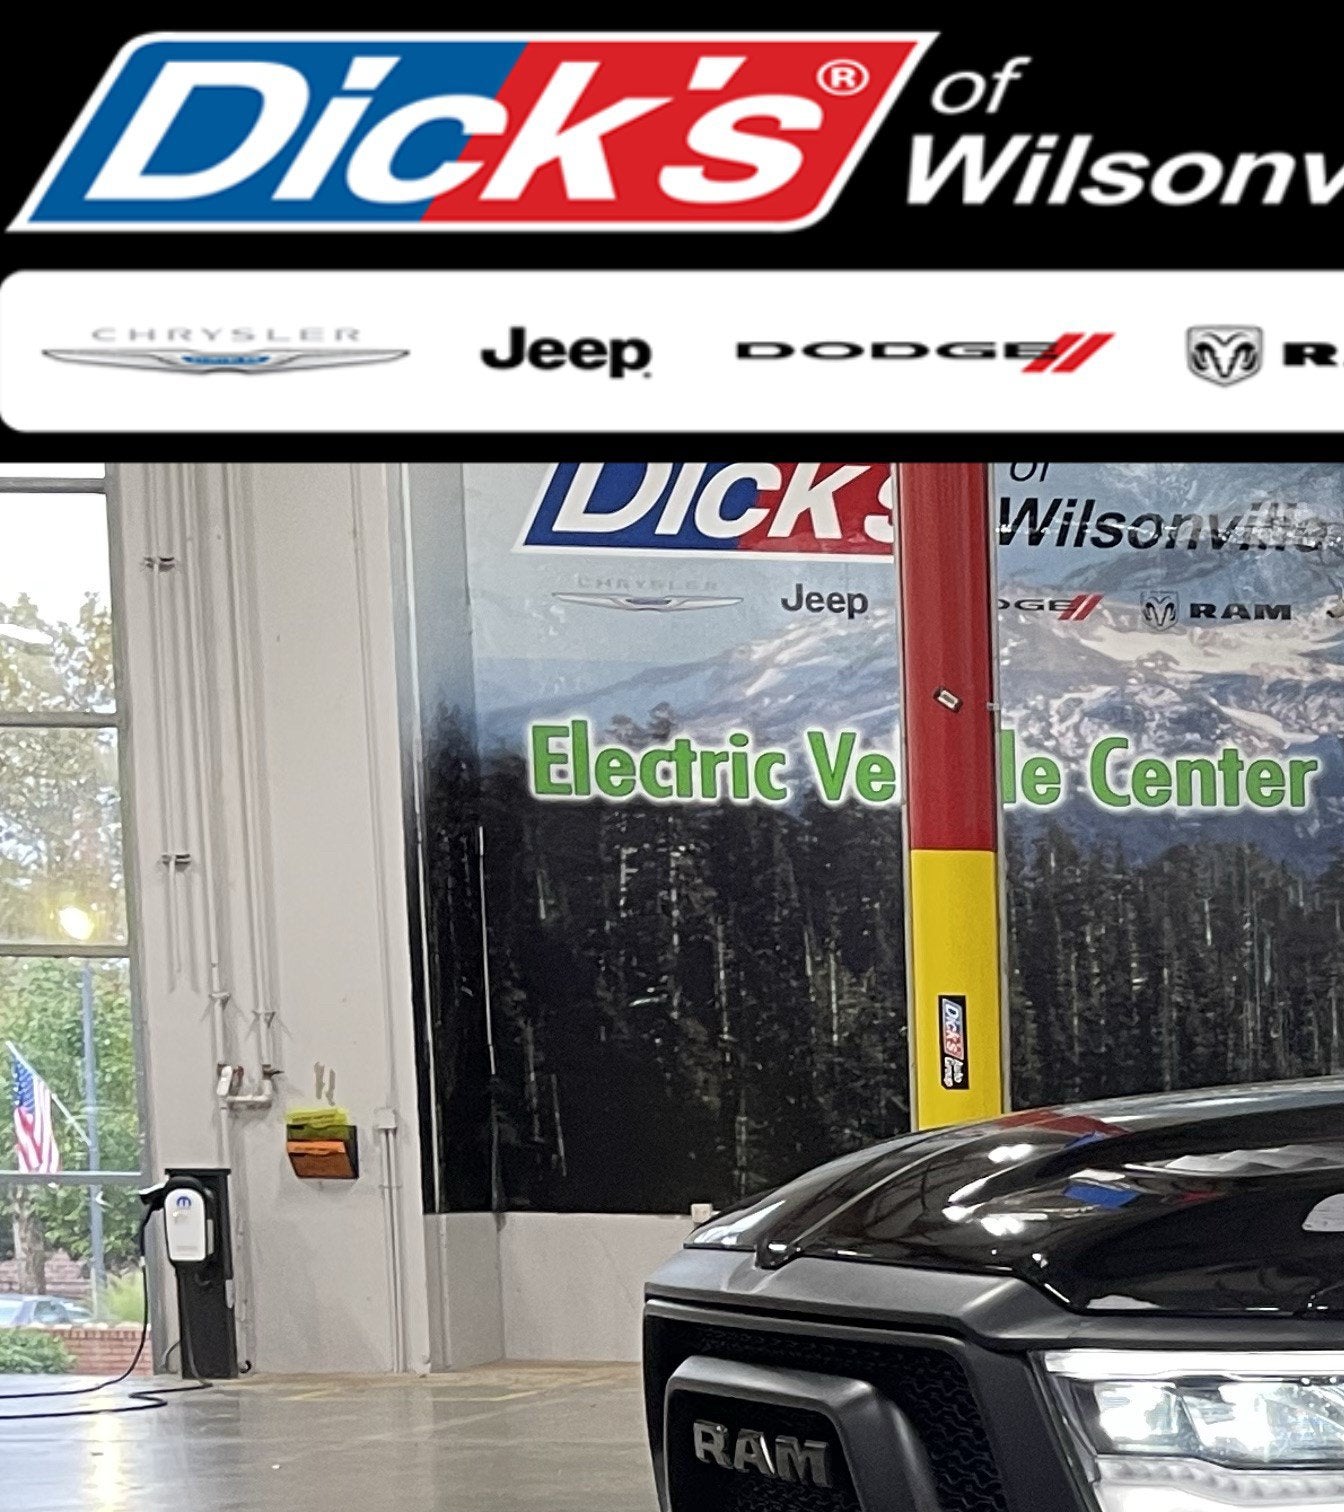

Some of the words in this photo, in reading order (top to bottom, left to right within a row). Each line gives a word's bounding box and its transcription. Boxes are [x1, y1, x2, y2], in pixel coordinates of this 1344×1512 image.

[780, 583, 870, 620] Jeep
[1189, 602, 1292, 621] RAM
[532, 720, 786, 800] Electric
[1090, 737, 1318, 807] Center
[693, 1418, 833, 1489] RAM
